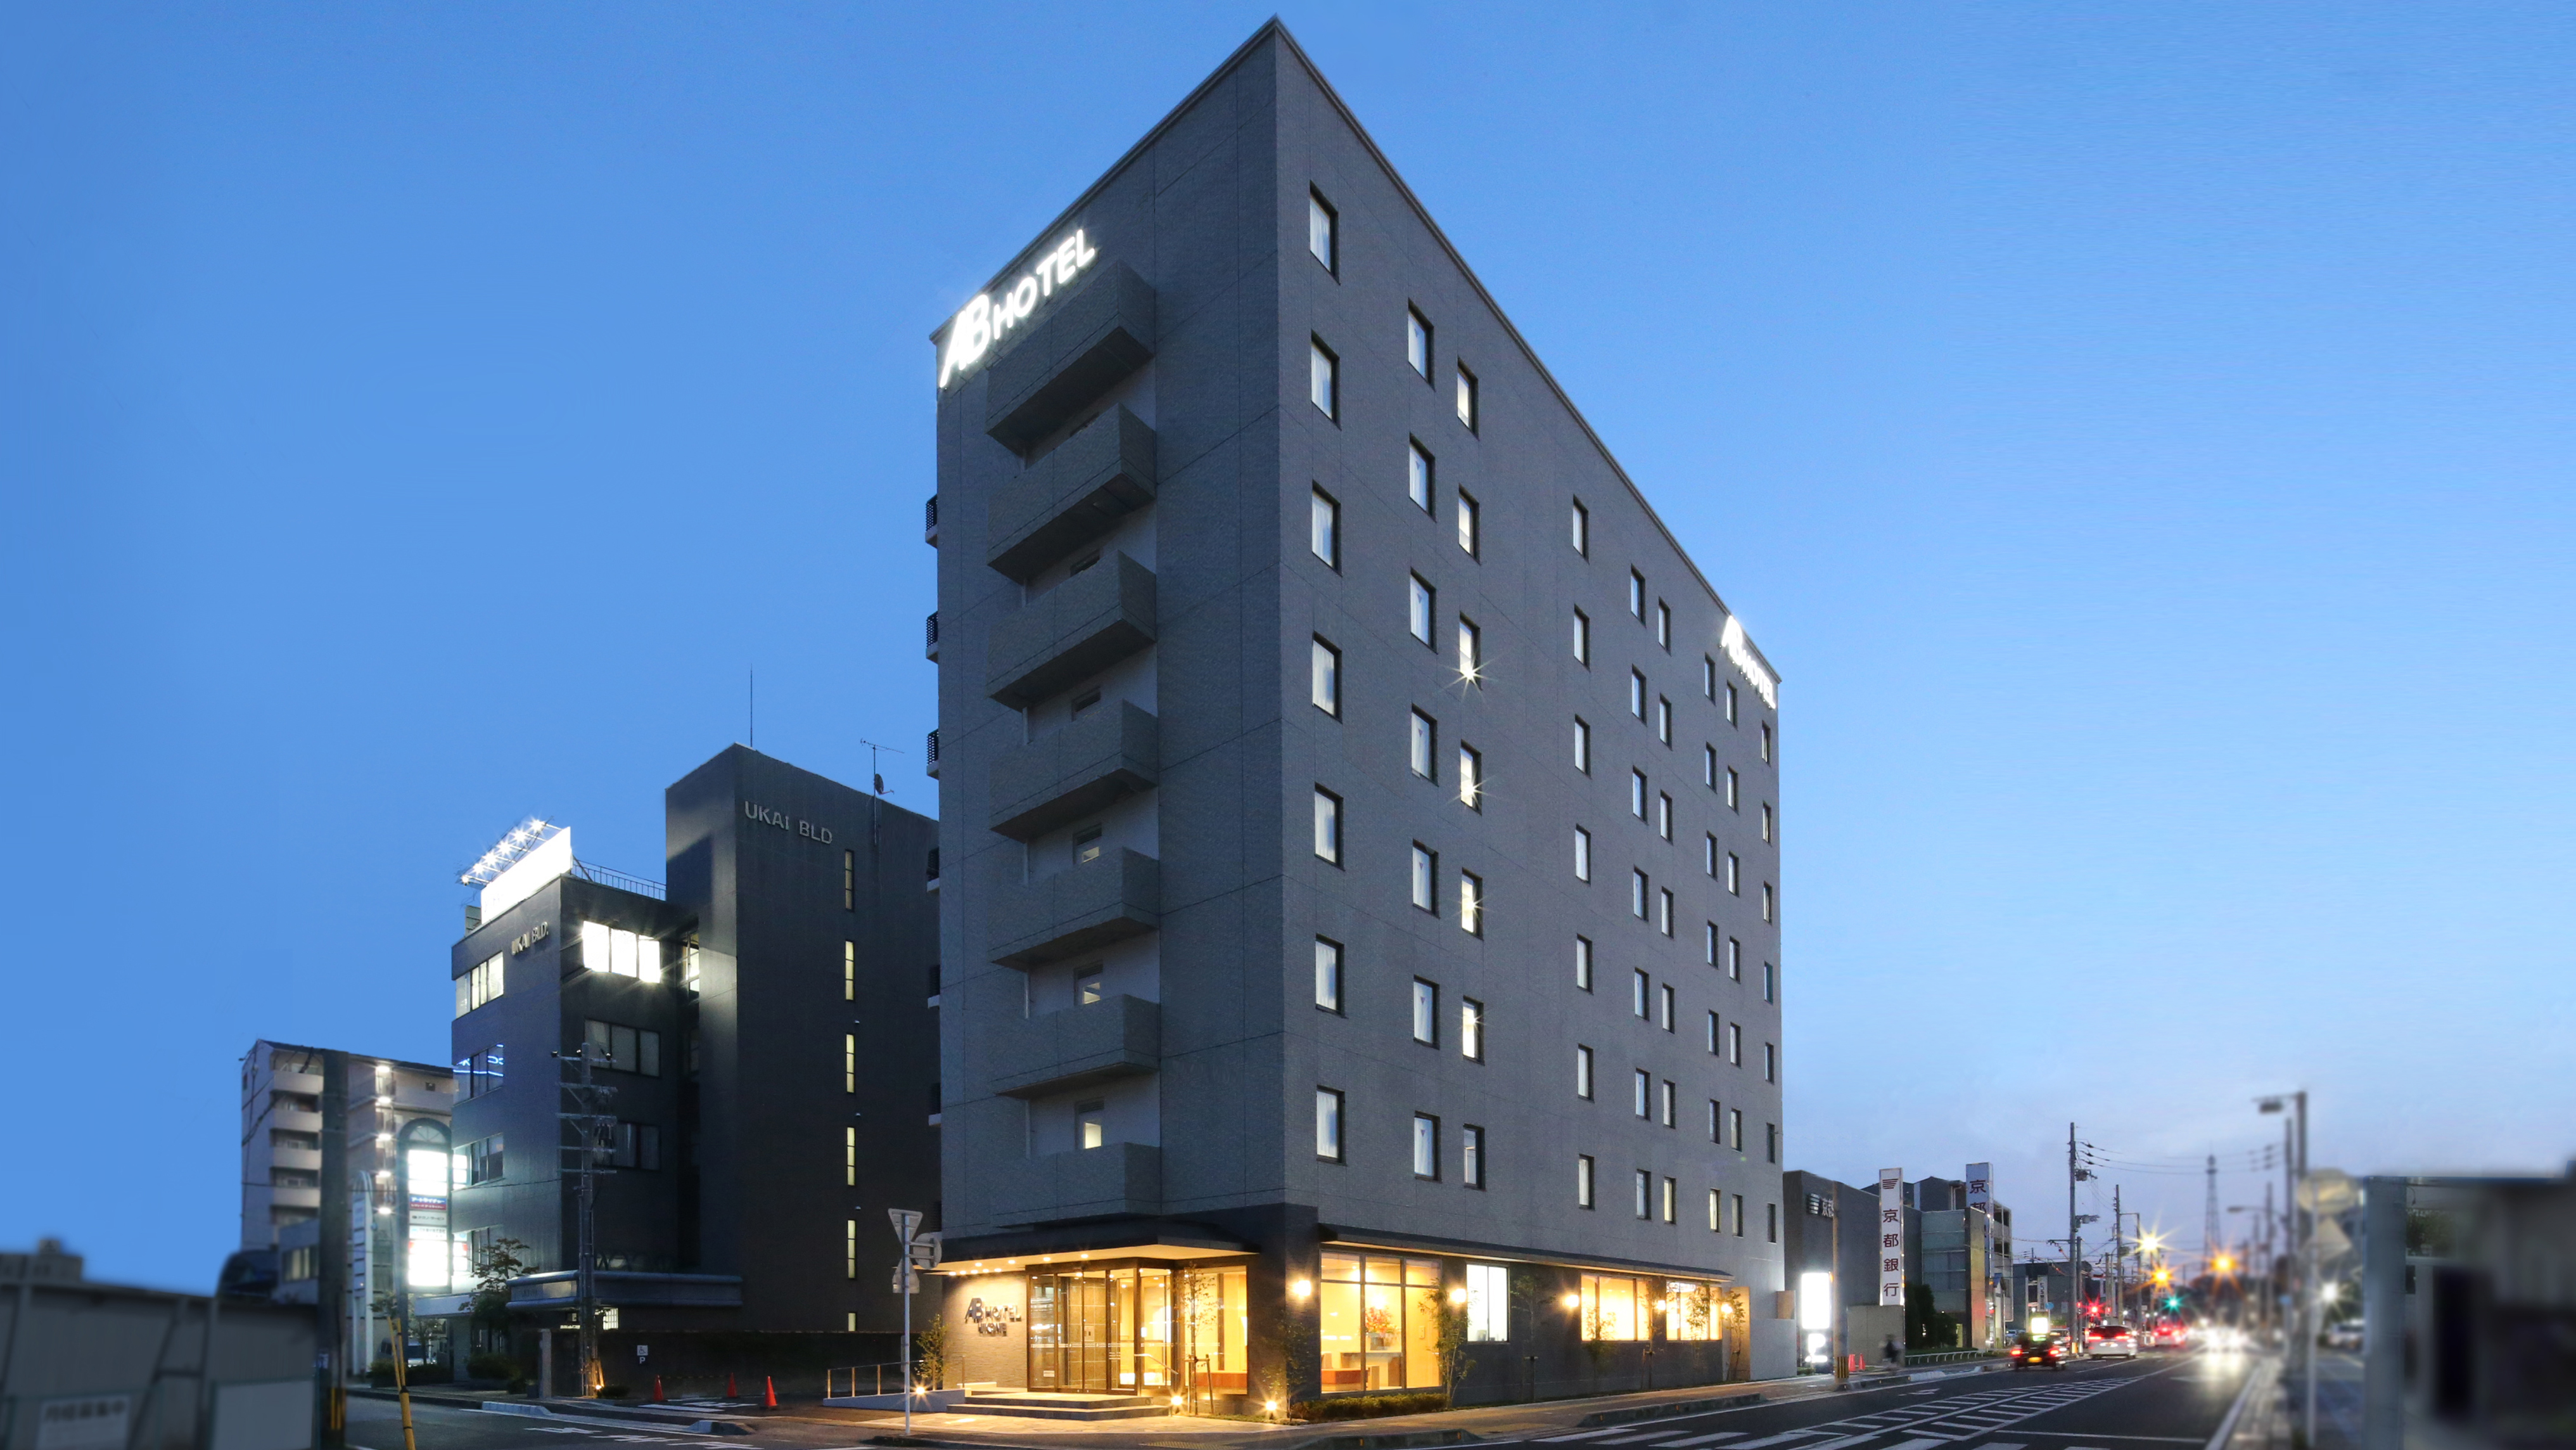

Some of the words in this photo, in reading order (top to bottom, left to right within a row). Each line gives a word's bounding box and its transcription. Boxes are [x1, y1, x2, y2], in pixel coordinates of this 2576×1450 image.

[940, 294, 991, 387] AB
[993, 229, 1095, 340] HOTEL
[745, 800, 789, 830] UKAI
[799, 819, 833, 844] BLD
[1882, 1209, 1899, 1297] 京都銀行
[964, 1298, 983, 1324] AB
[985, 1305, 1022, 1322] HOTEL
